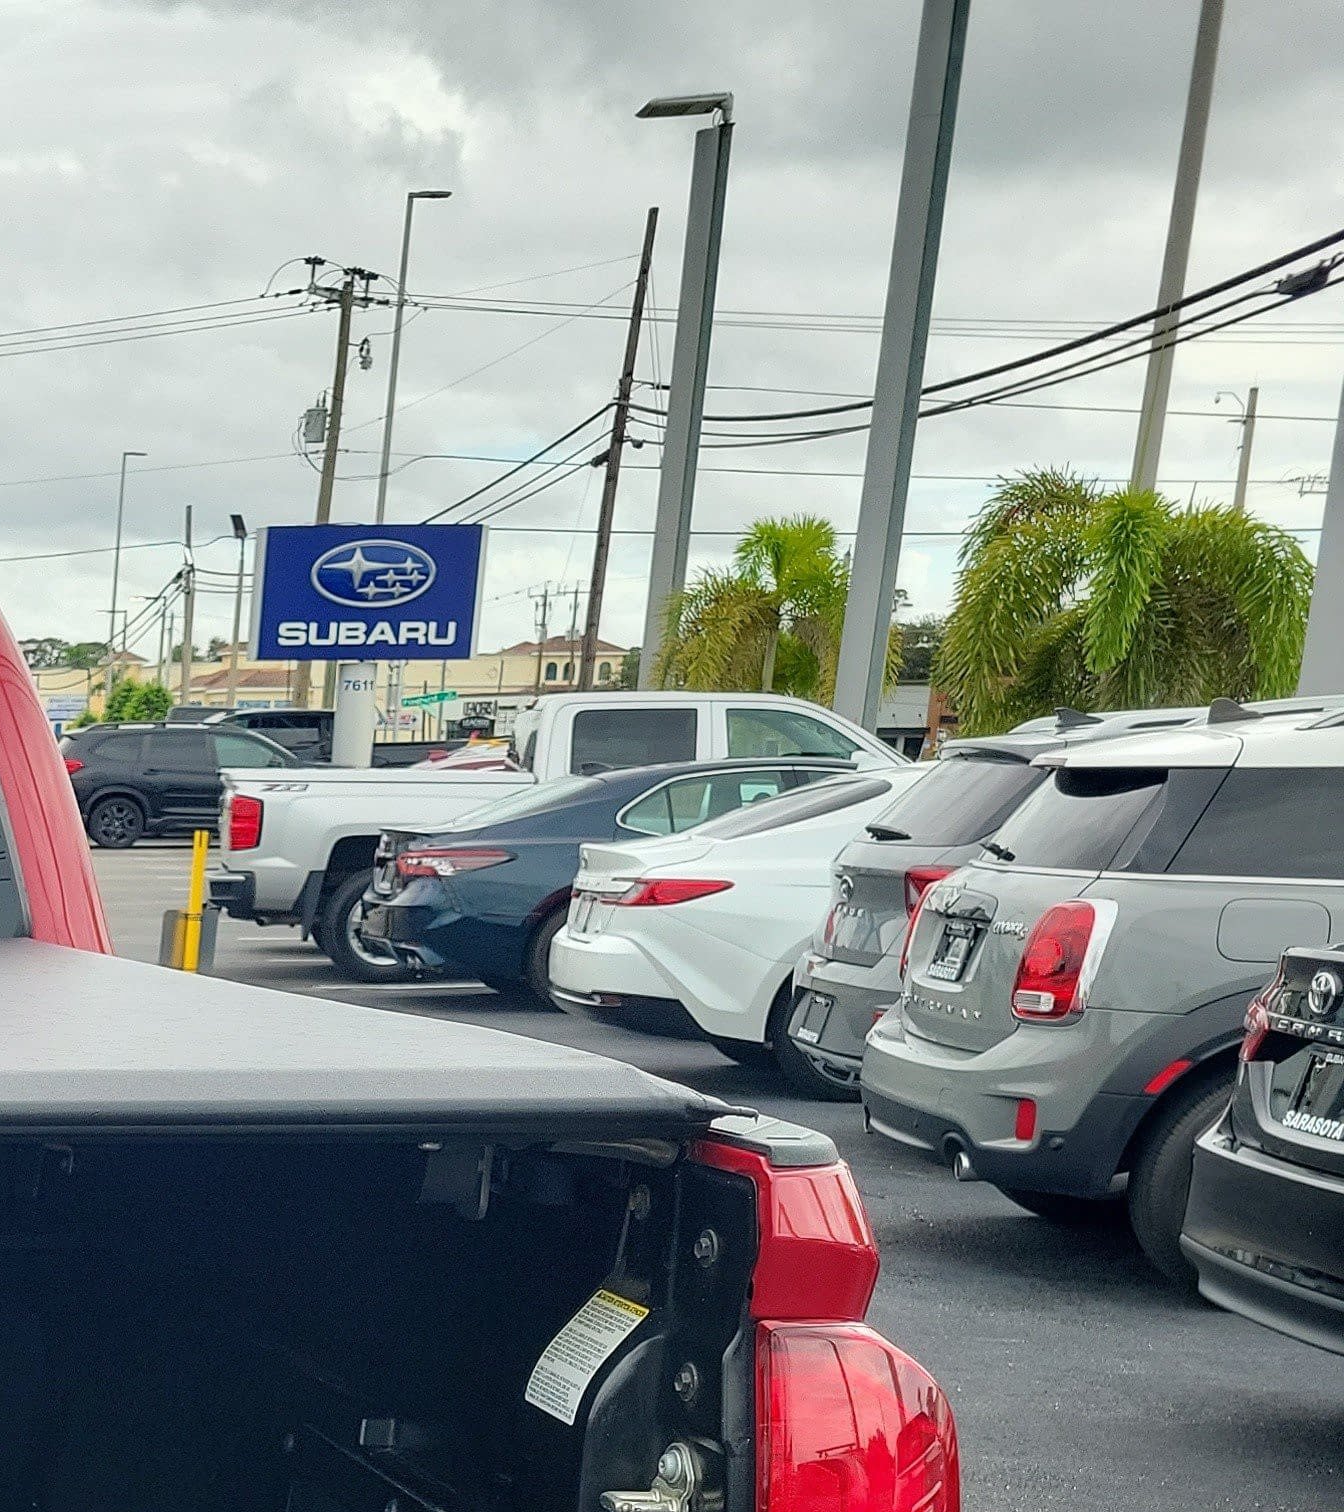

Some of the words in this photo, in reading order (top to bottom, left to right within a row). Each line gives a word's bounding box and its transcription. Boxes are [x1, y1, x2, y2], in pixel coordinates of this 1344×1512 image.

[276, 620, 458, 647] SUBARU
[343, 679, 375, 691] 7611
[1282, 1109, 1344, 1141] SARASOTA
